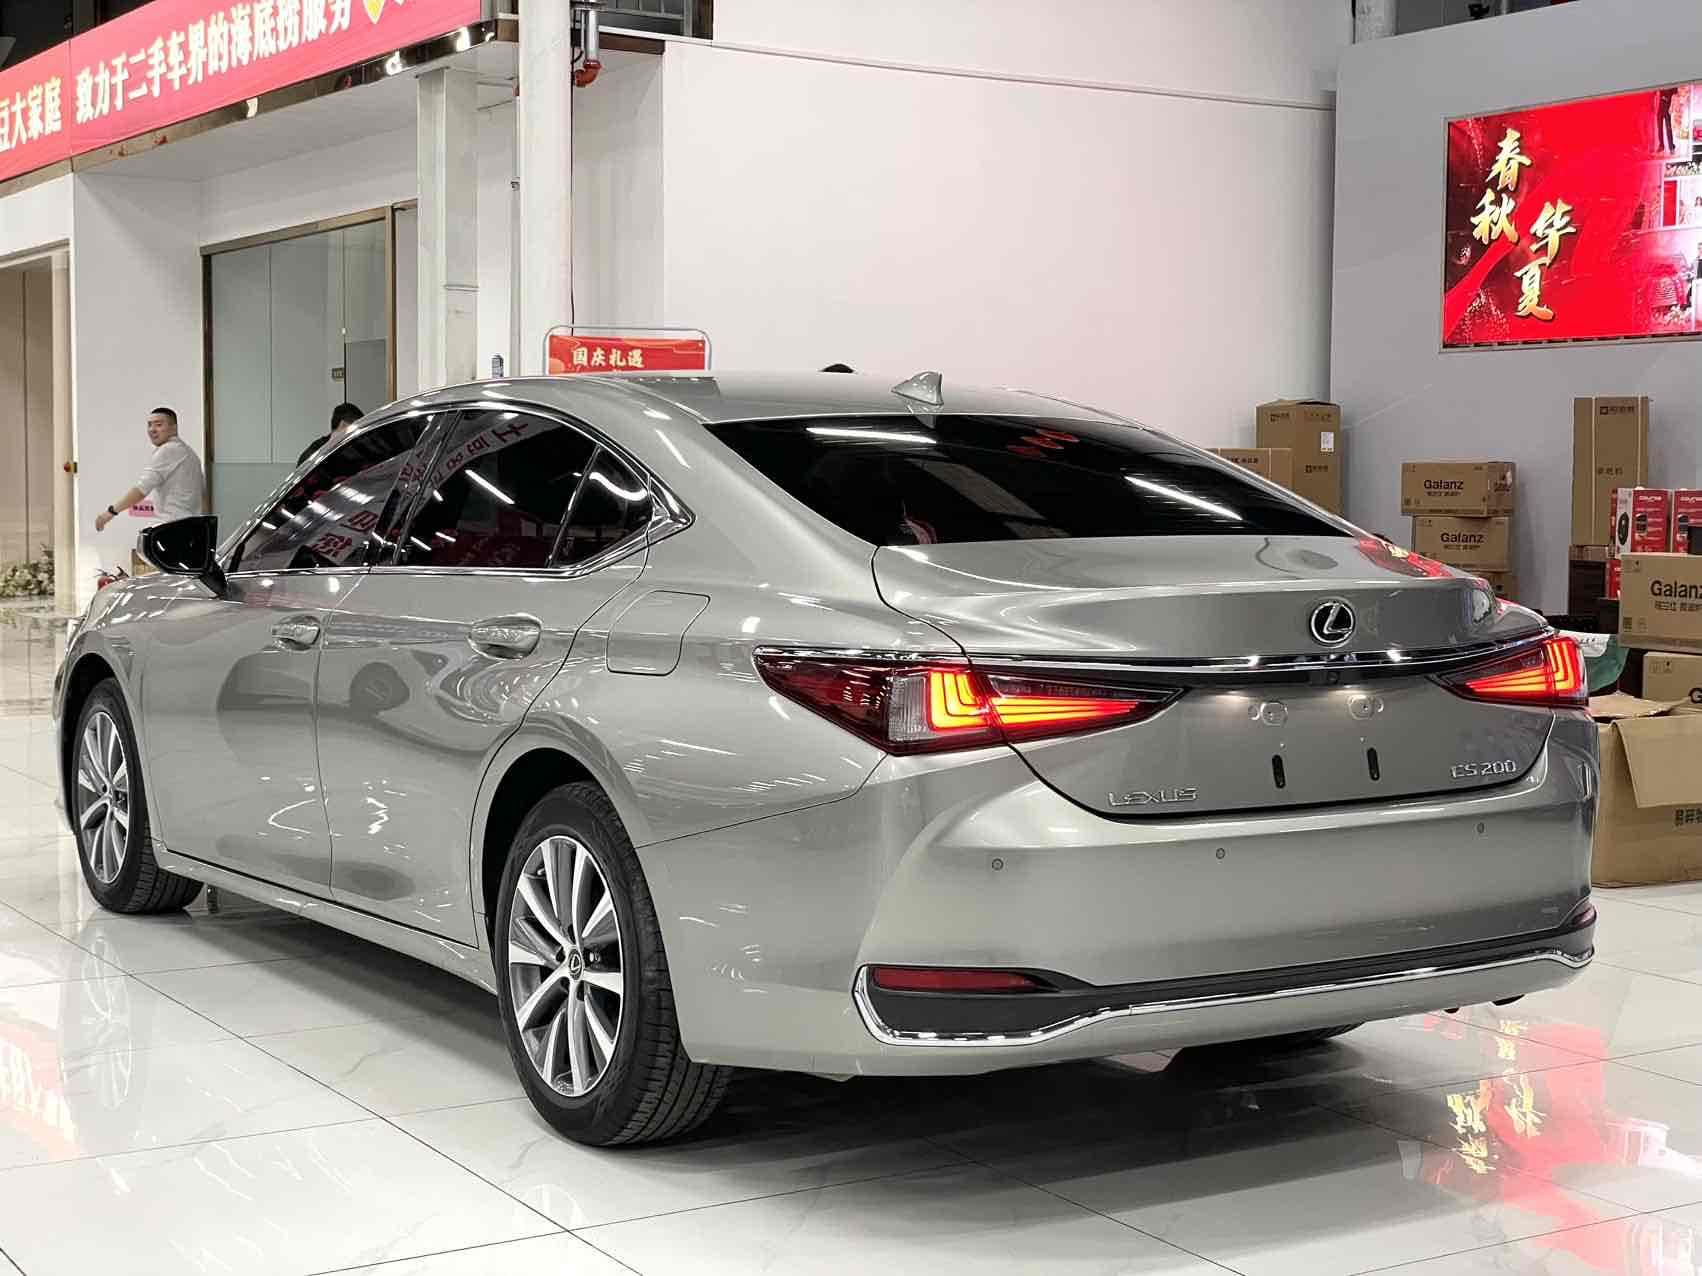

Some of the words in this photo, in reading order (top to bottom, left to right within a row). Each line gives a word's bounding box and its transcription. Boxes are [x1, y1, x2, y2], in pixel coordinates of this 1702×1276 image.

[1470, 127, 1533, 246] 春秋
[1513, 198, 1577, 321] 华夏
[572, 346, 645, 369] 国庆礼遇
[1423, 479, 1464, 490] Galanz
[1440, 532, 1485, 544] Galanz
[1480, 759, 1517, 776] 200
[1107, 787, 1198, 807] LEXUS
